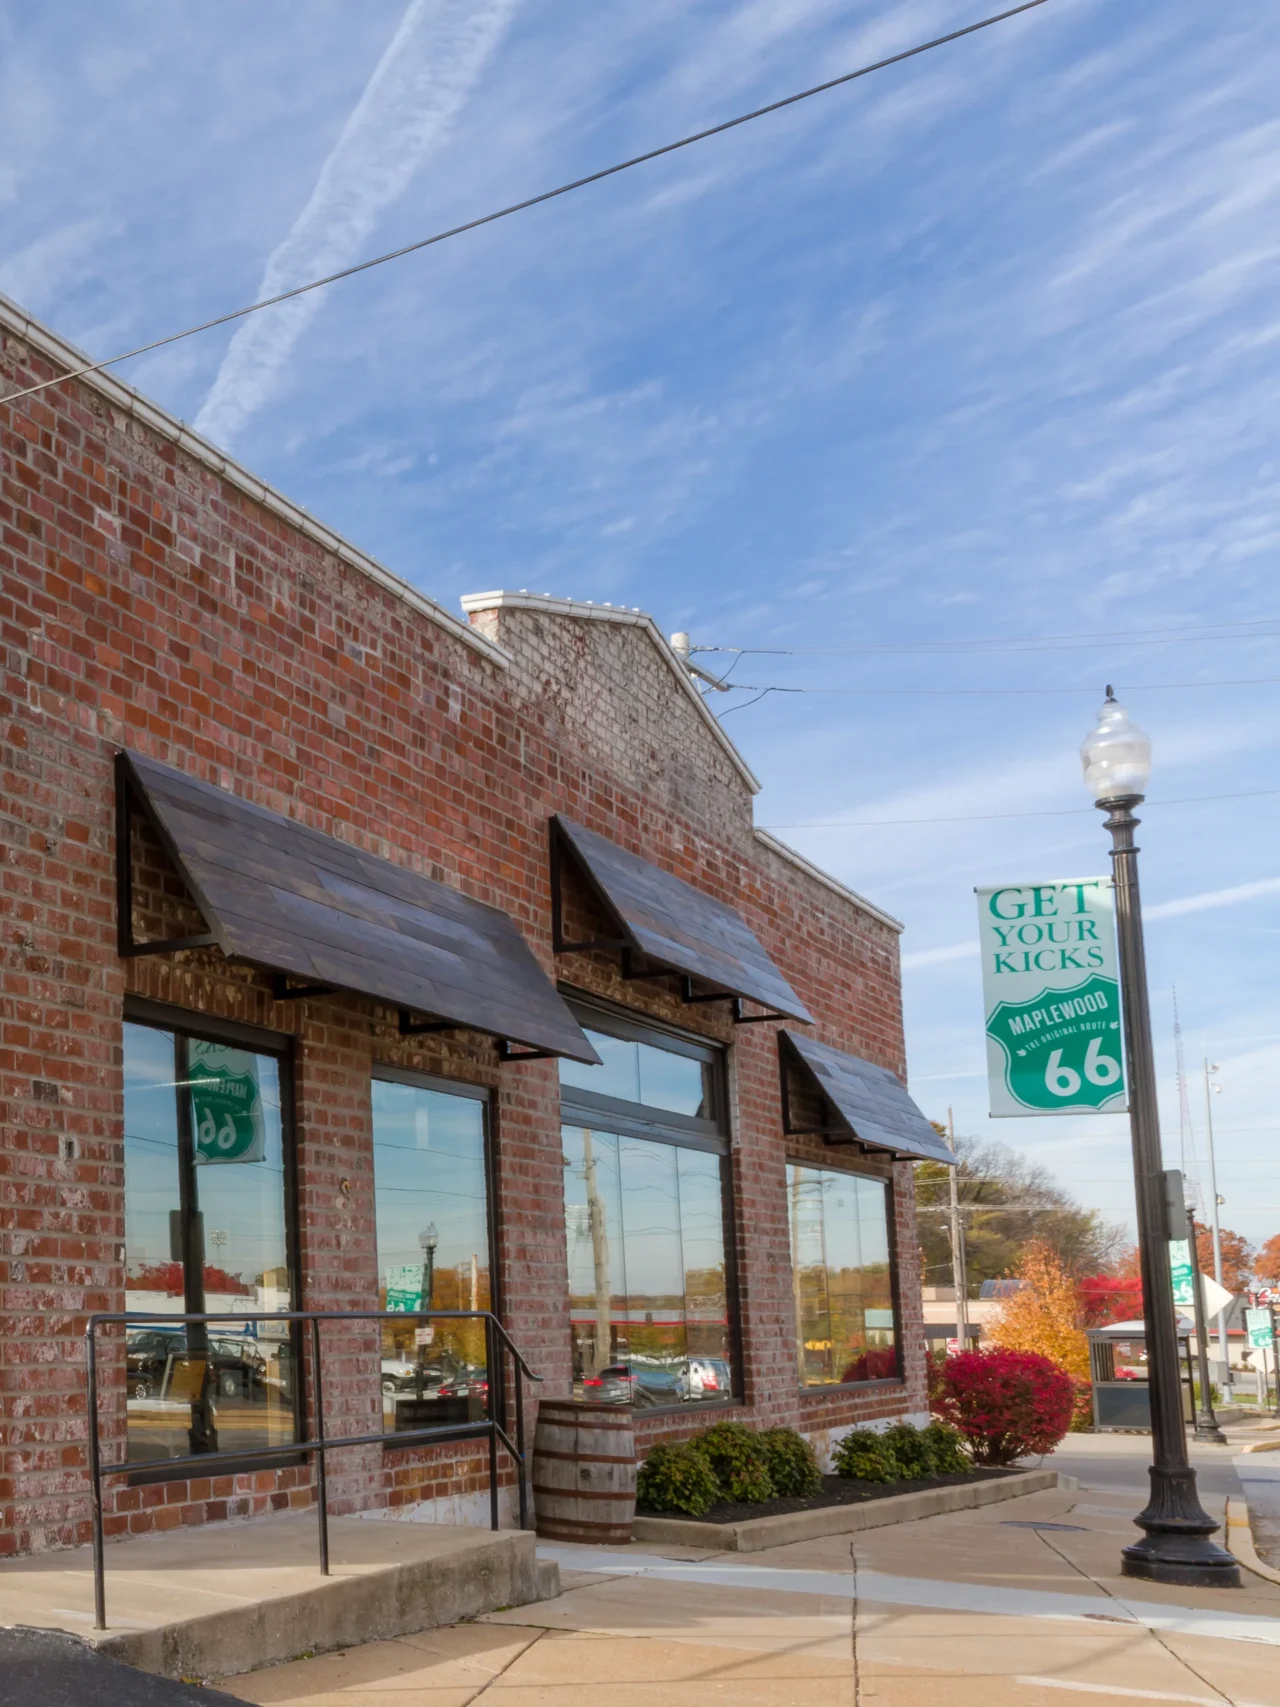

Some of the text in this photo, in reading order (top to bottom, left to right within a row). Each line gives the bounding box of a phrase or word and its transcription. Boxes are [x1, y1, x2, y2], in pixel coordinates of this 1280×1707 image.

[989, 881, 1099, 920] GET
[991, 919, 1100, 947] YOUR
[992, 946, 1104, 974] KICKS
[1008, 990, 1109, 1036] MAPLEWOOD
[1025, 1021, 1107, 1051] THE ORIGINAL ROUTE
[1045, 1036, 1121, 1097] 66
